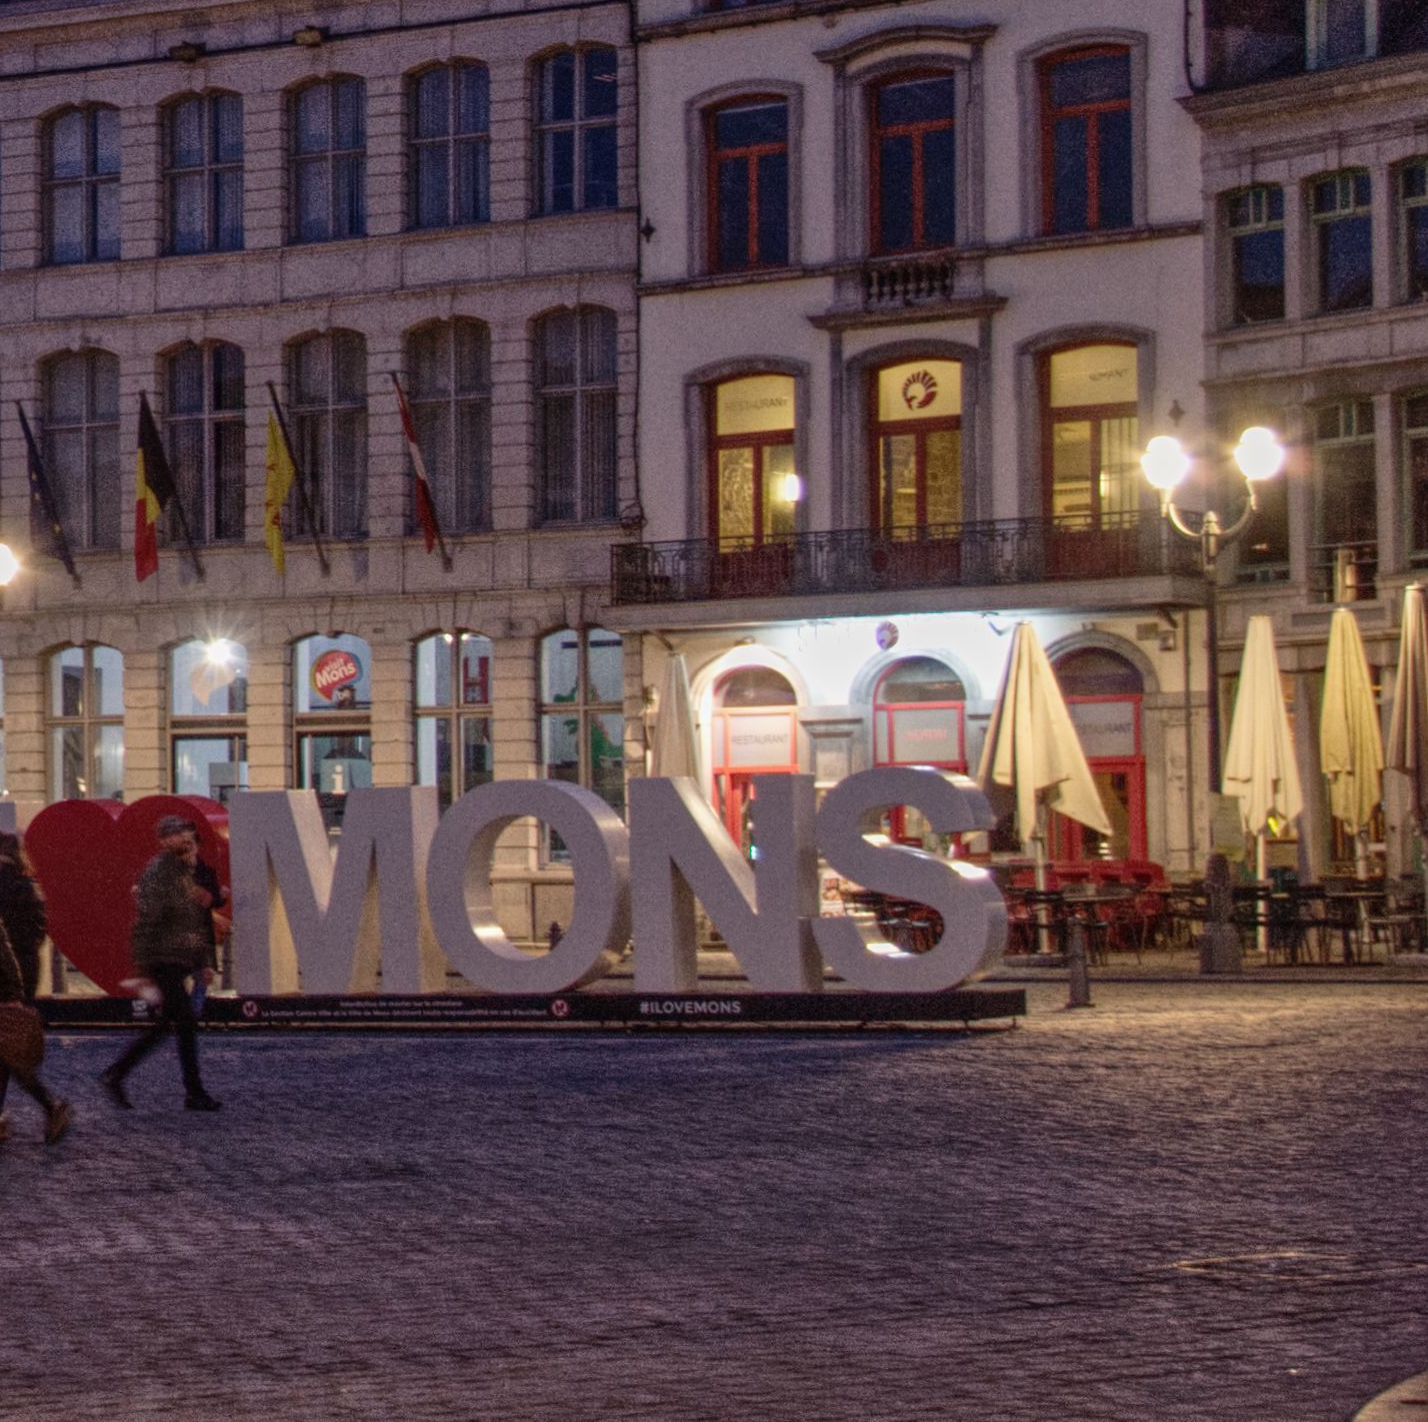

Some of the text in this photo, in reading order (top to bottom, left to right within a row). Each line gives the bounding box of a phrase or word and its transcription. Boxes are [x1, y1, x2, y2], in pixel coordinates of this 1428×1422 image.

[315, 662, 357, 688] Mons
[731, 733, 789, 746] RESTAURANT
[228, 766, 1010, 996] MONS
[640, 1000, 741, 1014] #ILOVEMONS
